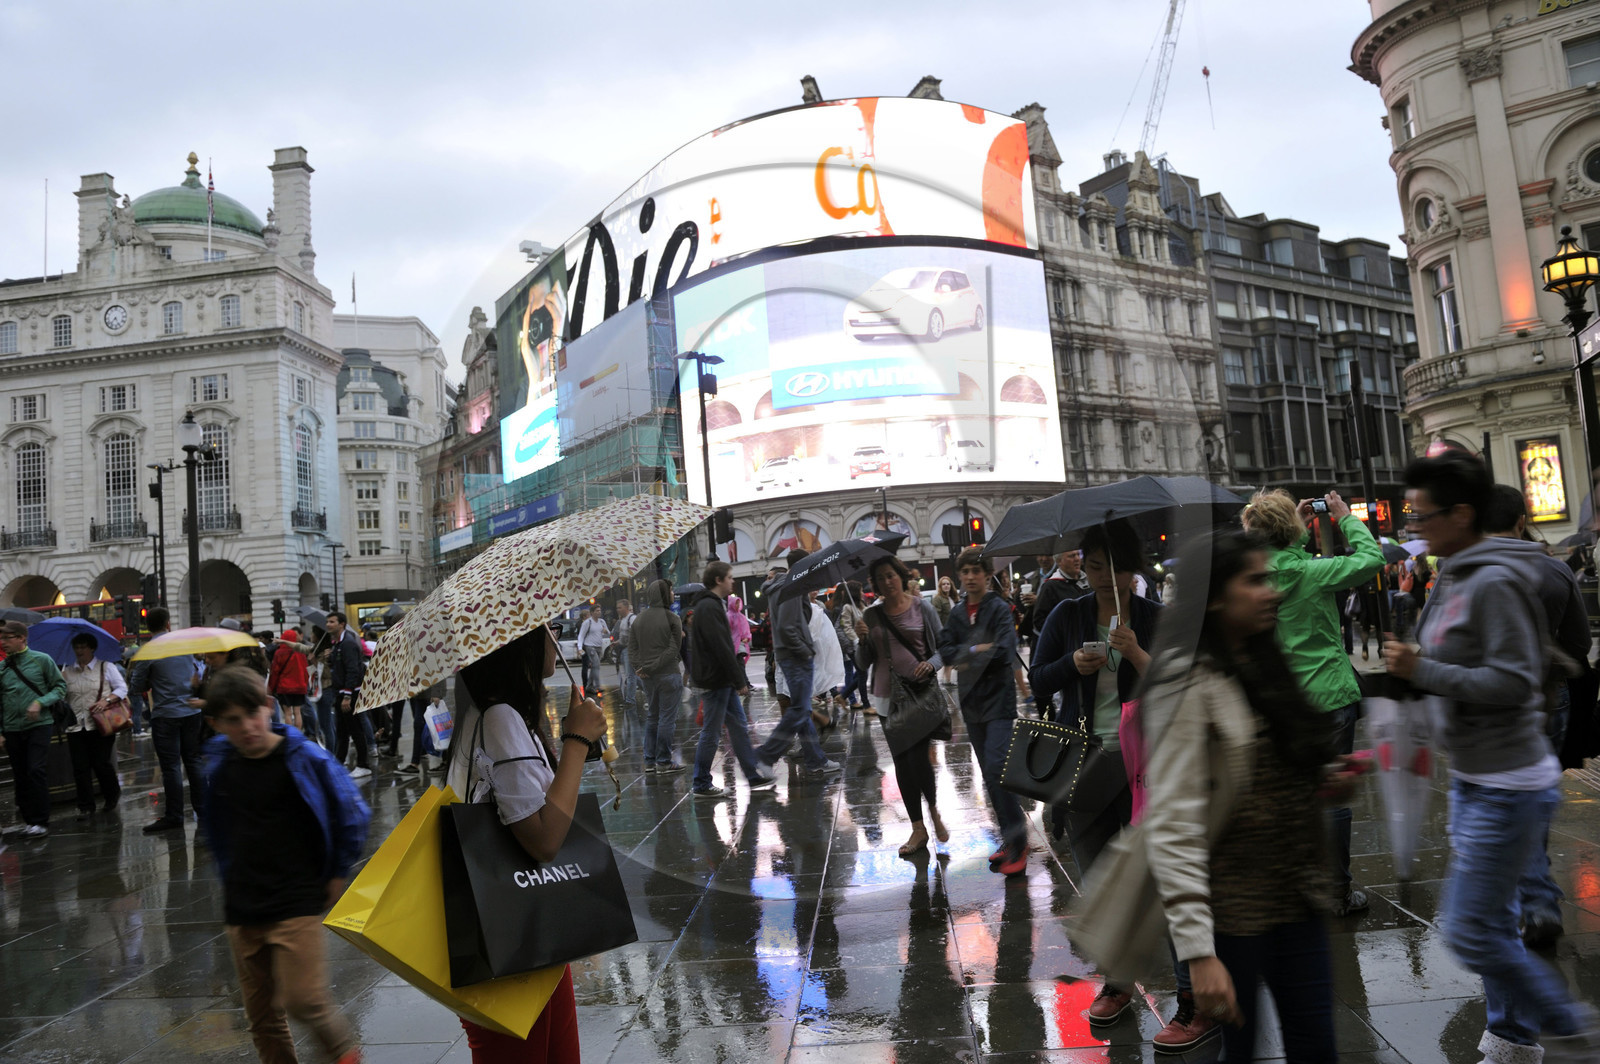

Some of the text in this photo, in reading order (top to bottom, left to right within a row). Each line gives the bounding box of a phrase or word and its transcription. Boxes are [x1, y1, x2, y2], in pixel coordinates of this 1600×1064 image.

[832, 365, 938, 391] HYUND
[822, 551, 840, 566] 2012
[513, 863, 590, 889] CHANEL
